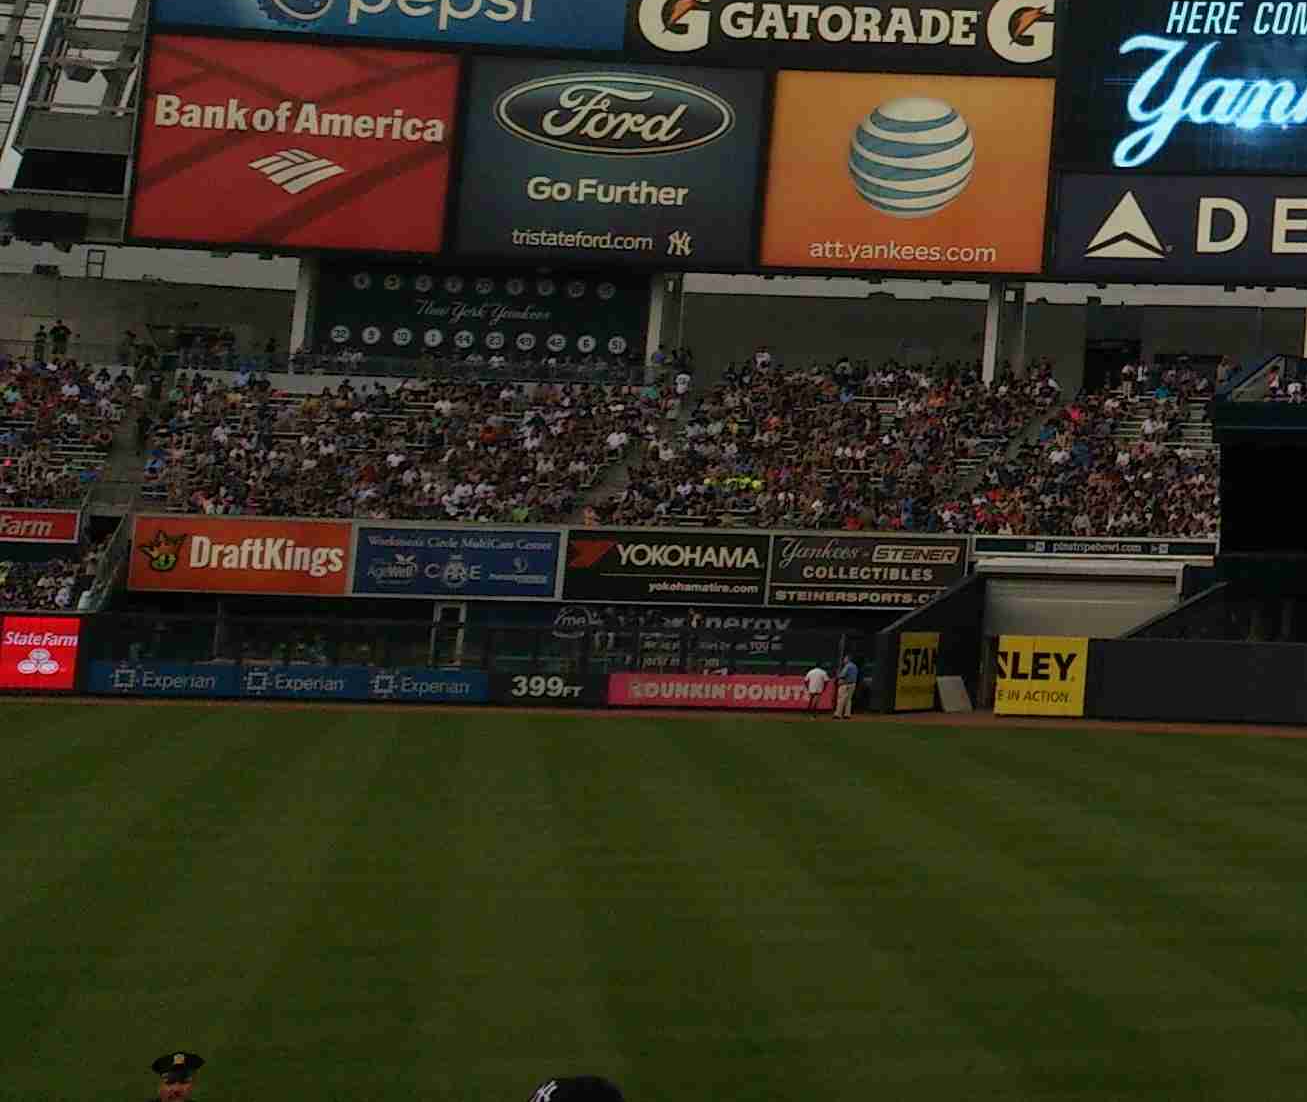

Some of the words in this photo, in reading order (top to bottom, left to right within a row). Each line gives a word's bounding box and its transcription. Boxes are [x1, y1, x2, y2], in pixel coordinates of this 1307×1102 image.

[720, 0, 980, 46] GATORADE
[1167, 1, 1242, 35] HERE
[155, 94, 250, 132] Bank
[252, 98, 292, 133] of
[297, 102, 445, 144] America
[542, 83, 688, 142] Ford
[527, 177, 572, 201] Go
[577, 178, 689, 206] Further
[512, 229, 653, 250] tristateford.com
[808, 238, 997, 264] att.yankees.com
[189, 535, 345, 578] DraftKings
[616, 544, 760, 569] YOKOHAMA
[780, 537, 859, 570] Yankees
[874, 547, 958, 562] STEINER
[802, 566, 933, 582] COLLECTIBLES
[649, 580, 758, 595] yokohamatire.com
[142, 670, 217, 693] Experian
[274, 672, 345, 694] Experian
[400, 676, 470, 697] Experian
[646, 682, 731, 699] DUNKIN'
[1008, 690, 1020, 700] IN
